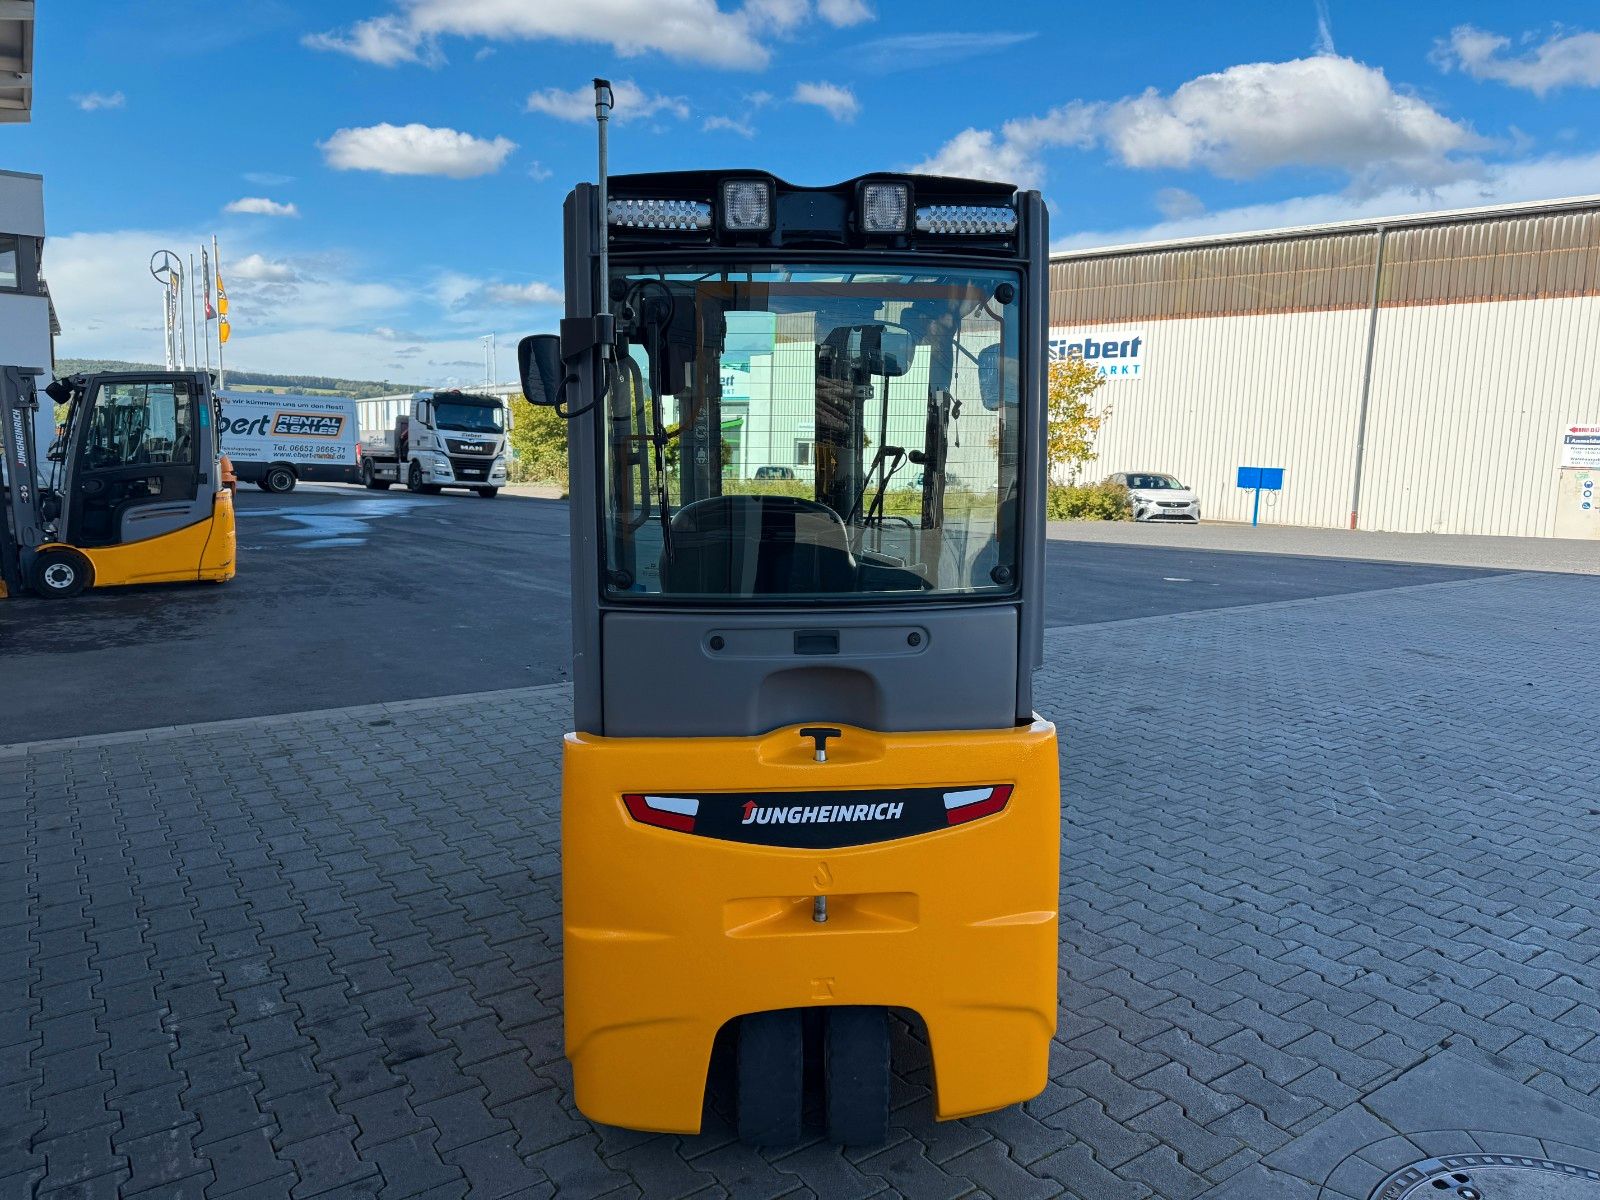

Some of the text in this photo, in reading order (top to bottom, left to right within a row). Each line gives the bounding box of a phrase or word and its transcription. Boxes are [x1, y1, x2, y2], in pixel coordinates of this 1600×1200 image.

[1099, 365, 1140, 375] ARKT
[220, 414, 270, 436] bert
[278, 415, 340, 426] RENTAL
[275, 424, 338, 435] & SALES
[12, 408, 26, 467] JUNGHEINRICH
[273, 443, 287, 451] Tel.
[289, 444, 313, 452] 06652
[742, 801, 904, 825] JUNGHEINRICH
